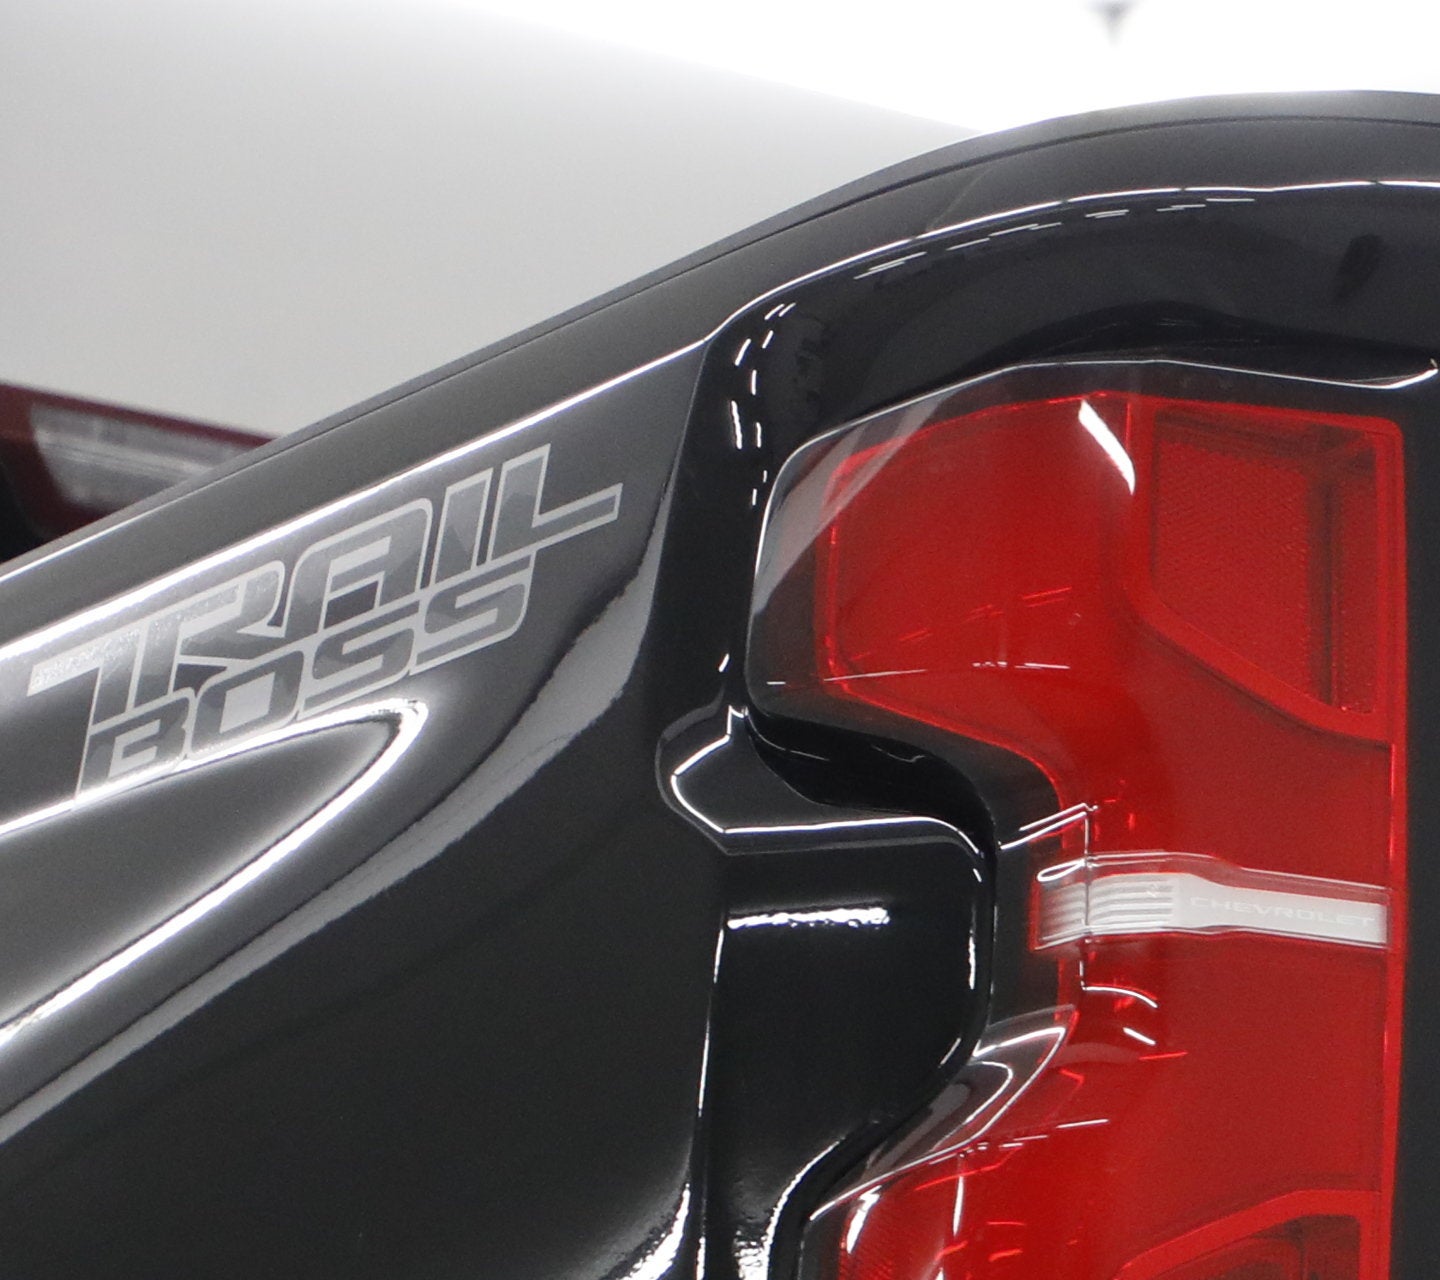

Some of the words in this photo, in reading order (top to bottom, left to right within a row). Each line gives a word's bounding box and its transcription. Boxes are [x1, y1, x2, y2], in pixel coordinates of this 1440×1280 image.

[27, 442, 624, 728] TRAIL
[73, 546, 538, 803] BOSS
[1189, 896, 1376, 928] CHEVROLET
